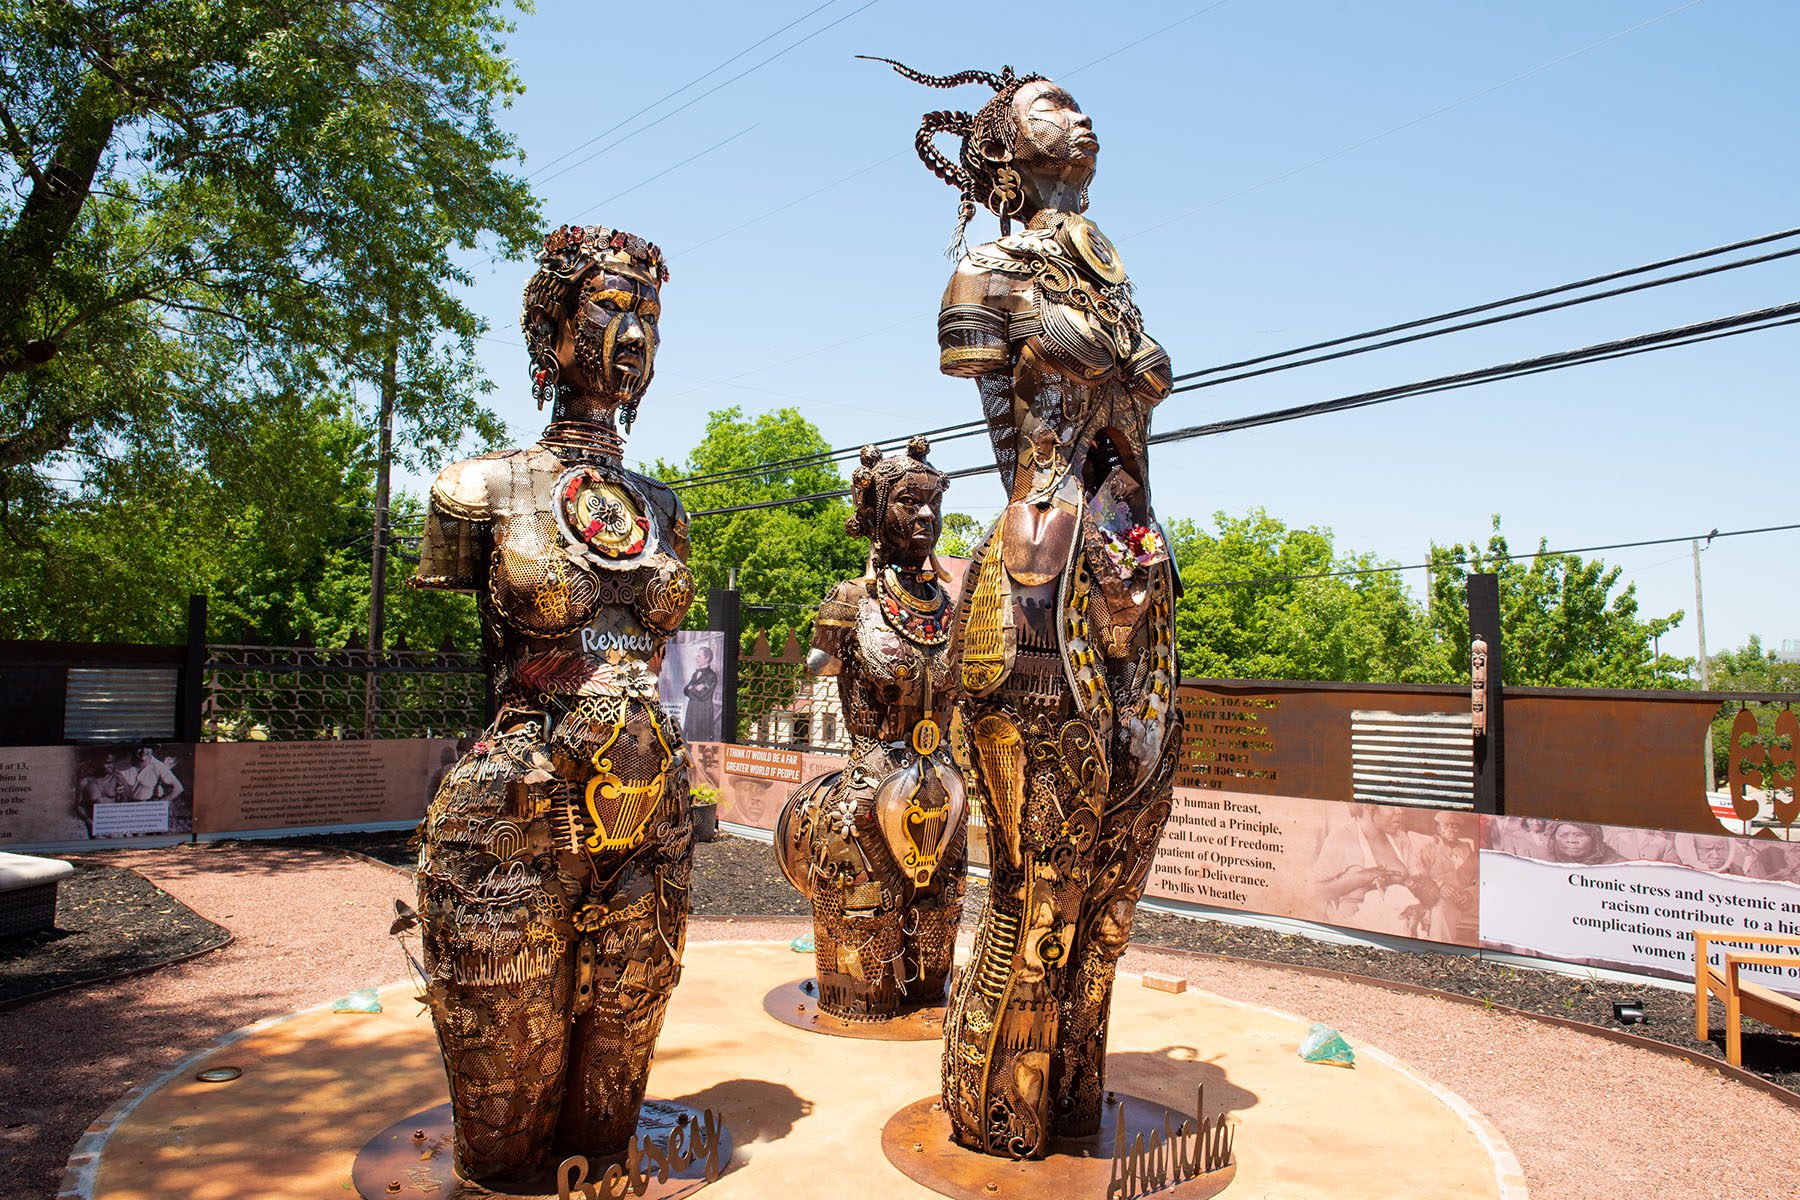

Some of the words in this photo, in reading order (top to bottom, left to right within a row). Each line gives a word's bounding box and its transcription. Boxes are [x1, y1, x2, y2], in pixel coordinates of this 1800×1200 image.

[581, 627, 654, 657] Respect
[729, 748, 745, 759] THINK
[746, 750, 751, 759] IT
[752, 750, 771, 762] WOULD
[773, 753, 780, 763] BE
[780, 754, 785, 763] A
[786, 754, 798, 765] FAR
[726, 761, 749, 773] GREATER
[750, 764, 769, 776] WORLD
[770, 766, 776, 777] IF
[777, 767, 799, 780] PEOPLE
[1184, 796, 1220, 810] human
[1224, 800, 1261, 814] Breast,
[1230, 818, 1282, 836] Principle,
[1169, 830, 1186, 841] call
[1190, 832, 1214, 844] Love
[1217, 836, 1228, 846] of
[1231, 836, 1284, 854] Freedom;
[1198, 851, 1209, 862] of
[1211, 851, 1276, 871] Oppression,
[1155, 863, 1182, 874] pants
[1184, 864, 1200, 876] for
[1202, 868, 1269, 888] Deliverance.
[1162, 879, 1195, 894] Phyllis
[1197, 884, 1248, 904] Wheatley
[1568, 873, 1626, 892] Chronic
[1630, 883, 1671, 898] stress
[1675, 890, 1704, 901] and
[1708, 893, 1776, 910] systemic
[1572, 916, 1672, 938] complications
[1602, 900, 1650, 915] racism
[1654, 907, 1734, 926] contribute
[1744, 917, 1759, 930] to
[1764, 921, 1772, 932] a
[1632, 944, 1686, 960] women
[1106, 1082, 1236, 1200] Anarcha
[556, 1108, 722, 1200] Betsey
